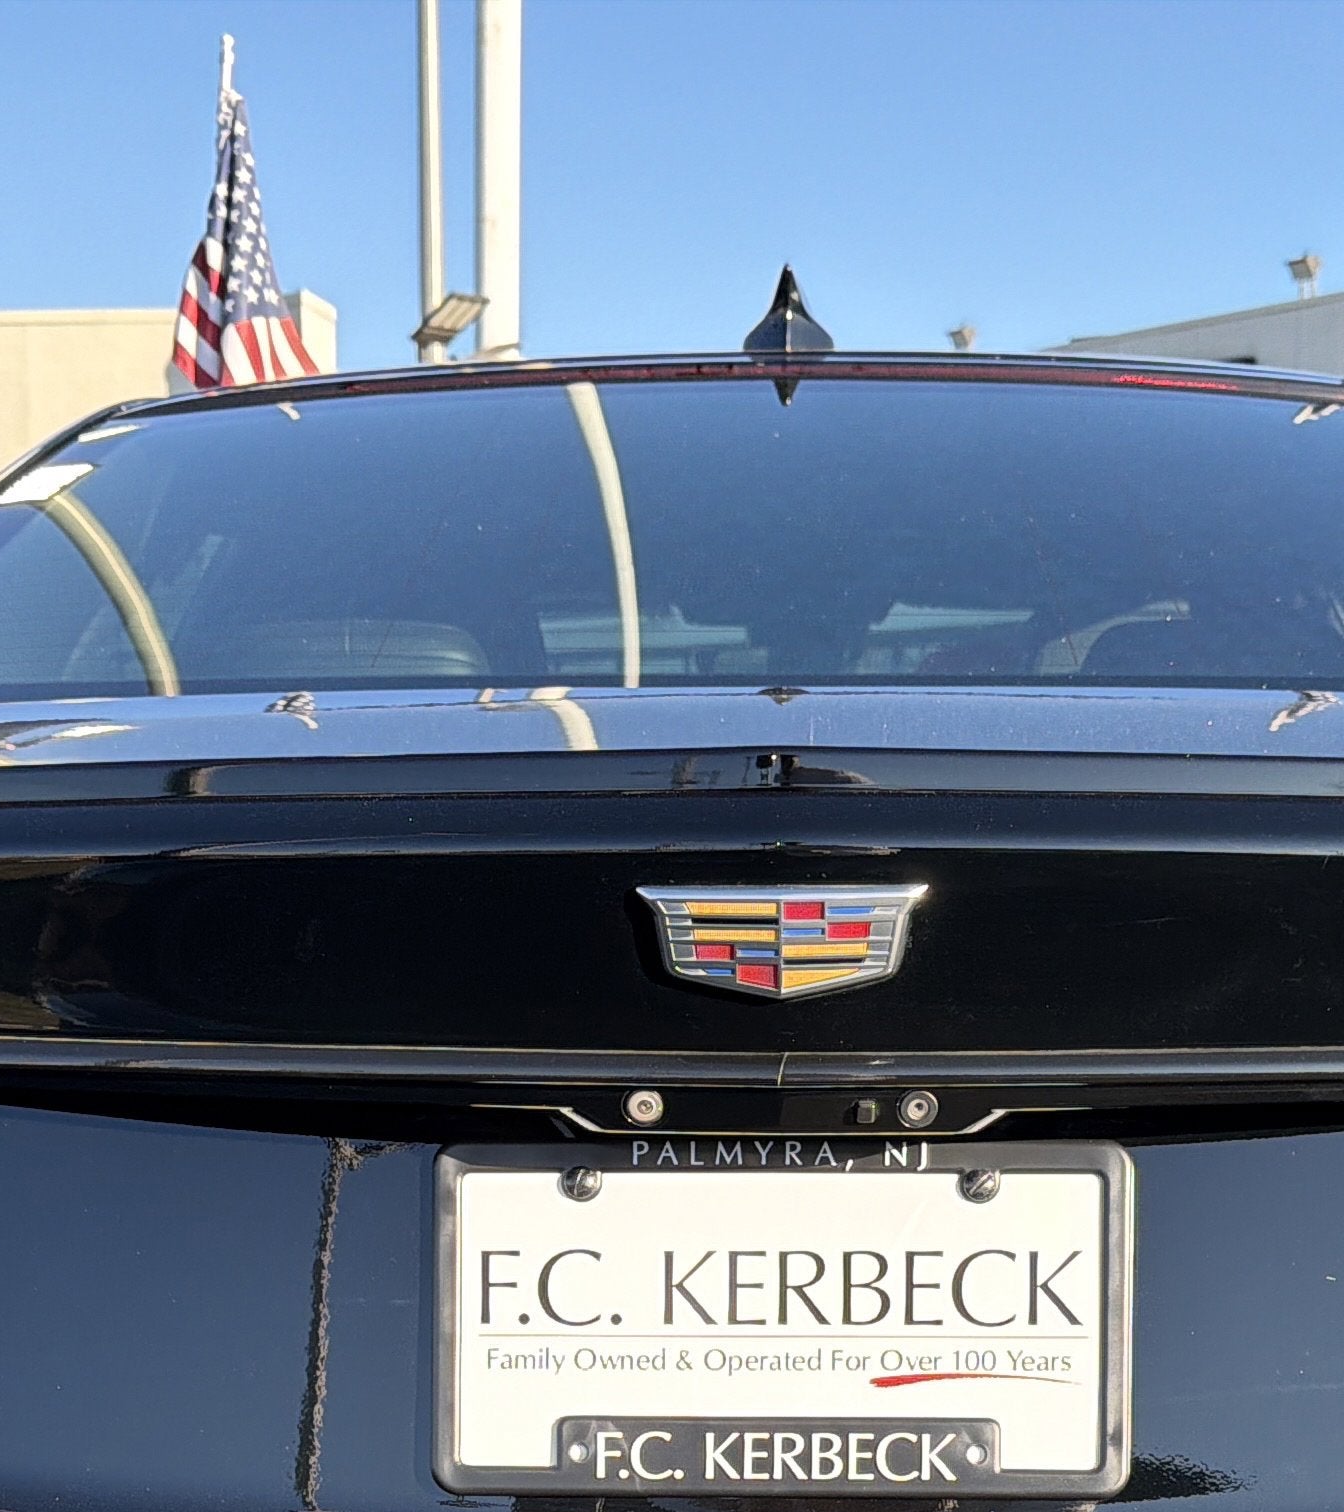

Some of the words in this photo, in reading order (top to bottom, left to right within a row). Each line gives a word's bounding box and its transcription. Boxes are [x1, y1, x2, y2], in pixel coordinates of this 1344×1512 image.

[632, 1140, 854, 1172] PALMYRA,
[883, 1141, 929, 1171] NJ
[479, 1249, 624, 1327] F.C.
[663, 1249, 1085, 1328] KERBECK
[487, 1347, 566, 1375] Family
[573, 1348, 667, 1372] Owned
[675, 1350, 694, 1371] &
[703, 1348, 822, 1376] Operated
[831, 1350, 871, 1372] For
[880, 1350, 943, 1372] Over
[953, 1350, 997, 1372] 100
[1006, 1350, 1073, 1372] Years
[595, 1432, 687, 1482] F.C.
[704, 1432, 959, 1483] KERBECK
